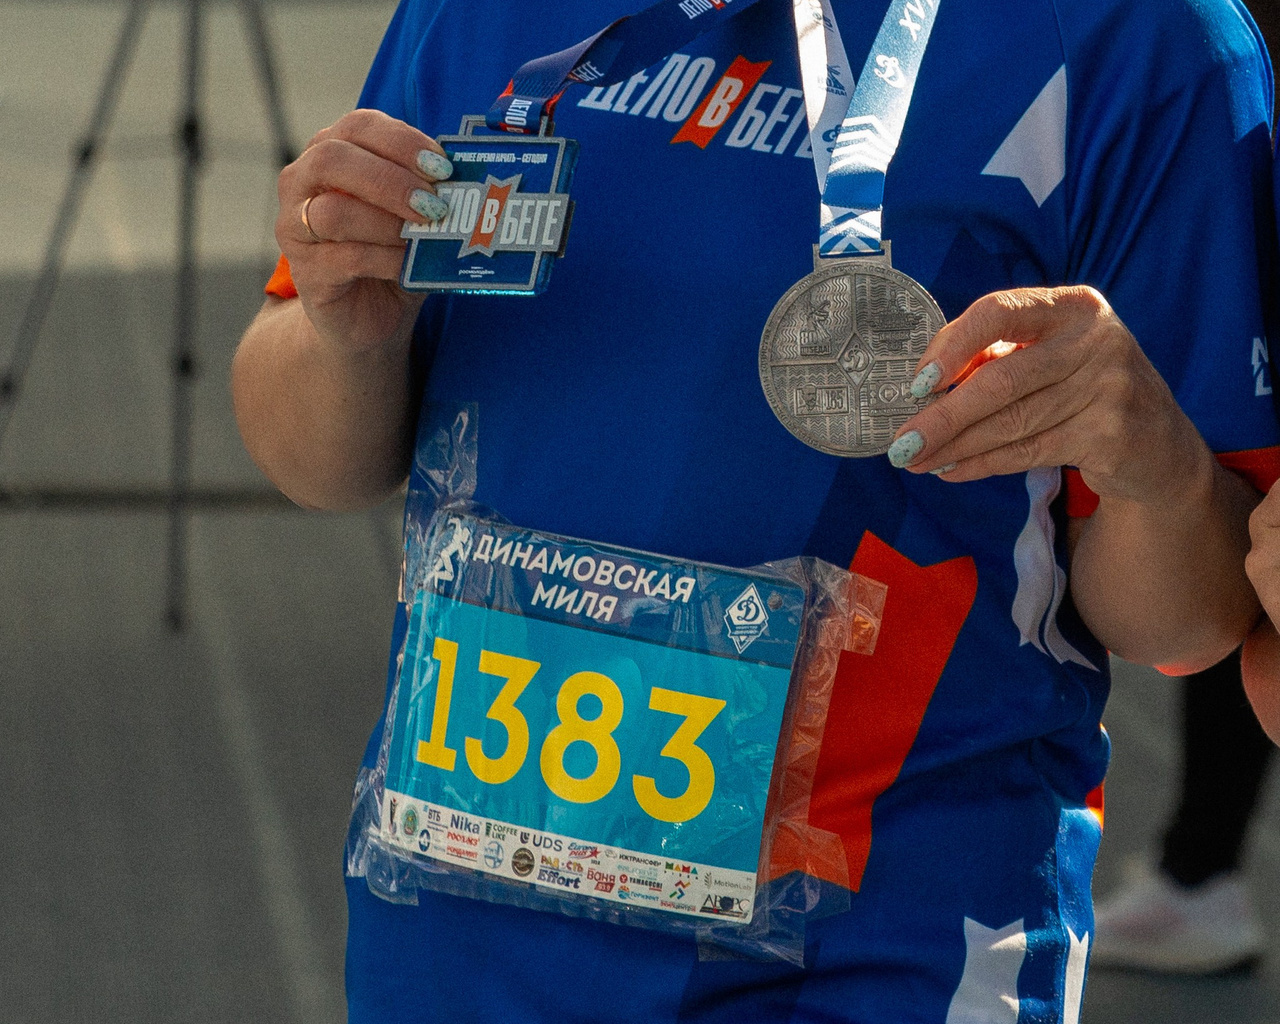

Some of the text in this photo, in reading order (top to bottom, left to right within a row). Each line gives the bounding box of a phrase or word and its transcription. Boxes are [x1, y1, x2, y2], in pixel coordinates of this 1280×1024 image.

[505, 98, 532, 126] ДЕЛО
[697, 76, 744, 128] В
[724, 82, 814, 160] БЕГ
[409, 188, 562, 247] ЕЛО В БЕГЕ
[472, 534, 696, 604] ДИНАМОВСКАЯ
[530, 580, 619, 622] МИЛЯ
[416, 637, 728, 824] 1383
[450, 814, 480, 834] Nika
[493, 823, 518, 837] COFFEE
[491, 831, 507, 841] LIKE
[532, 835, 563, 852] UDS
[537, 869, 581, 889] Effort
[629, 877, 663, 889] YAMAGUCHI
[714, 879, 752, 891] MotionLab
